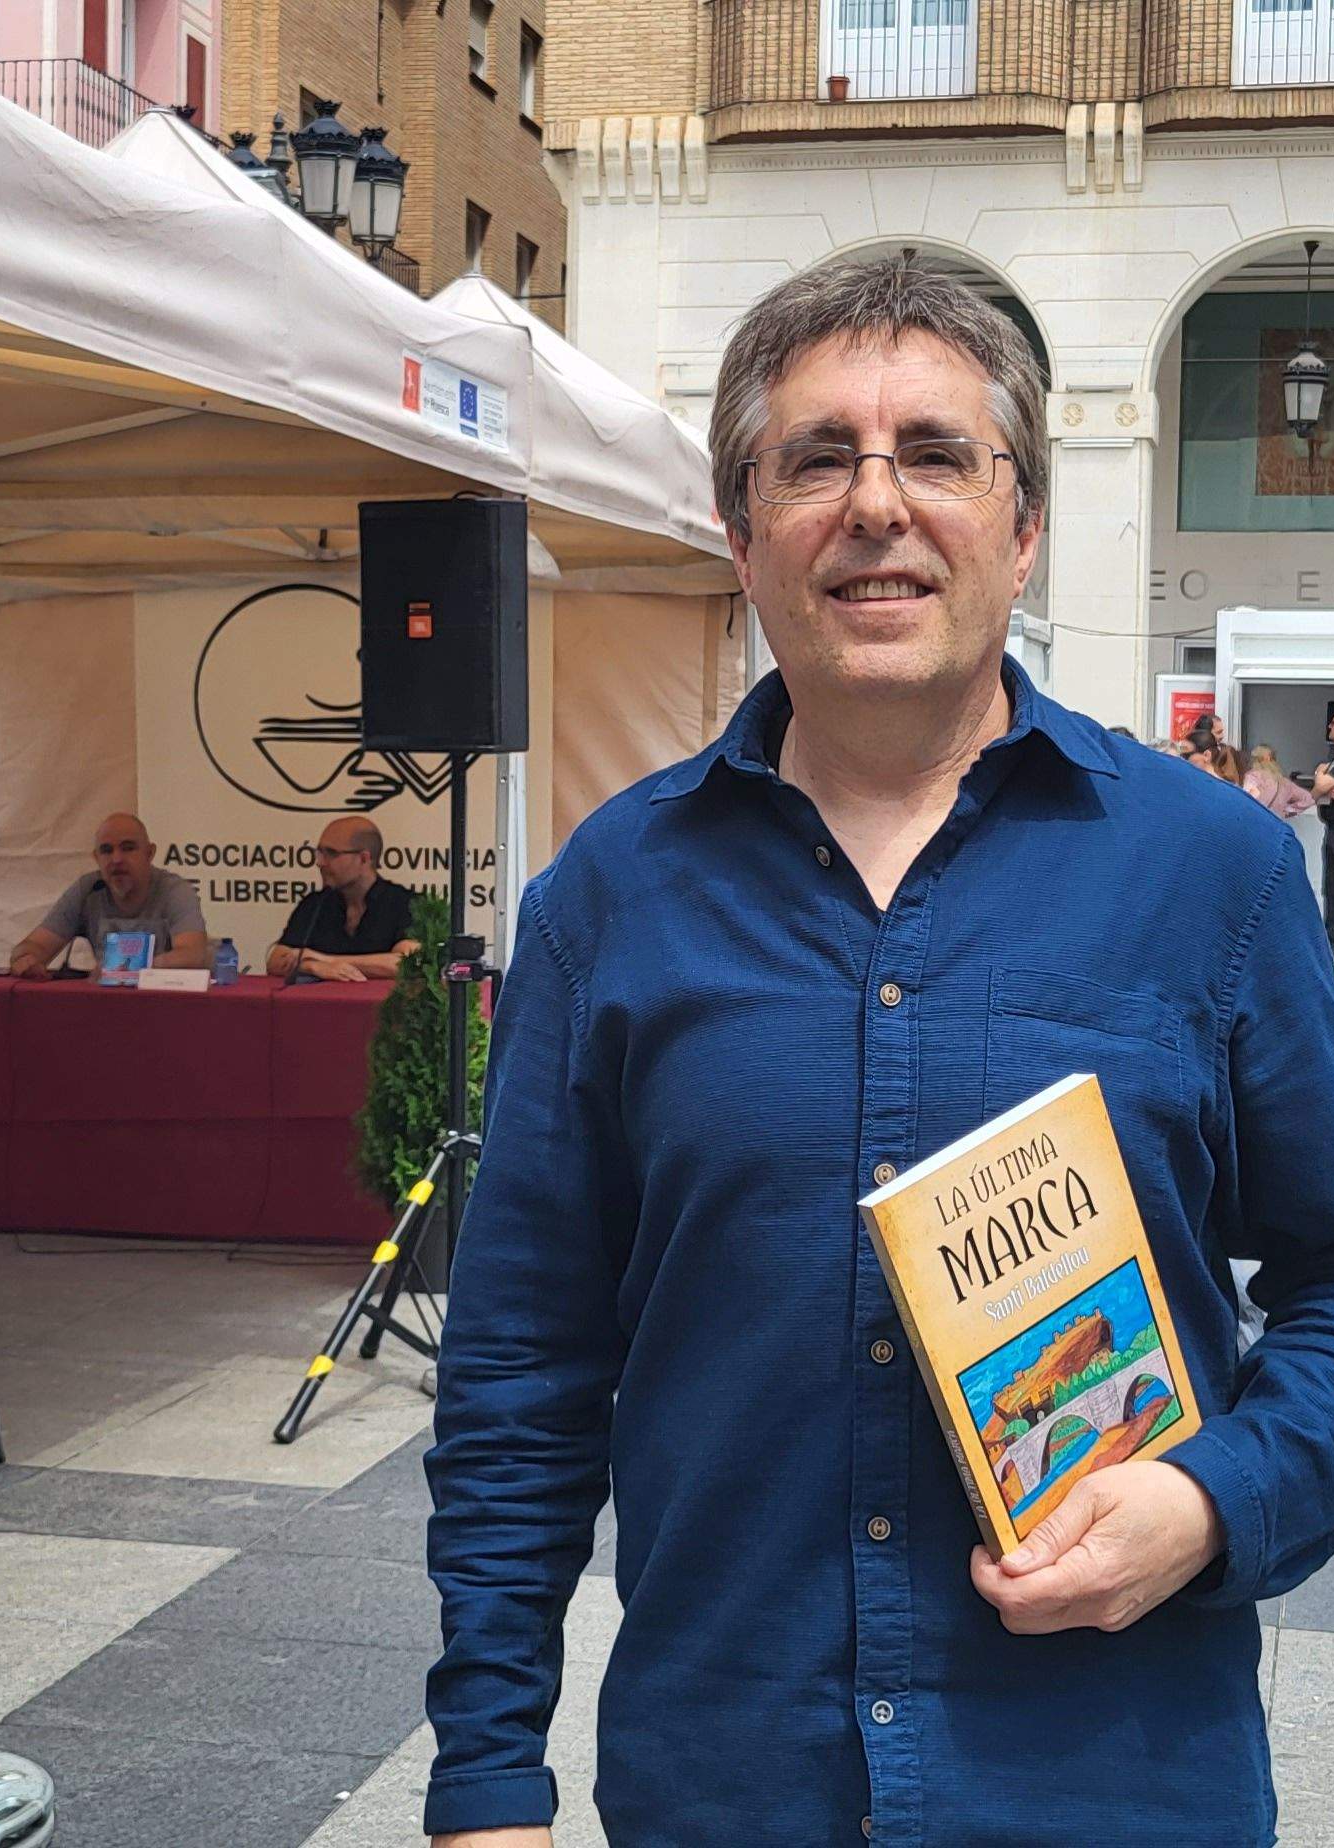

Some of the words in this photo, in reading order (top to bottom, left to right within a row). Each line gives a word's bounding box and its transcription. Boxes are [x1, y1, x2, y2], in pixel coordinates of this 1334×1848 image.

[163, 840, 318, 868] ASOCIACIÓ
[934, 1185, 971, 1227] LA
[968, 1132, 1059, 1204] ÚLTIMA
[936, 1166, 1100, 1305] MARCA
[984, 1285, 1025, 1329] Santi
[1023, 1246, 1091, 1300] Baldellou
